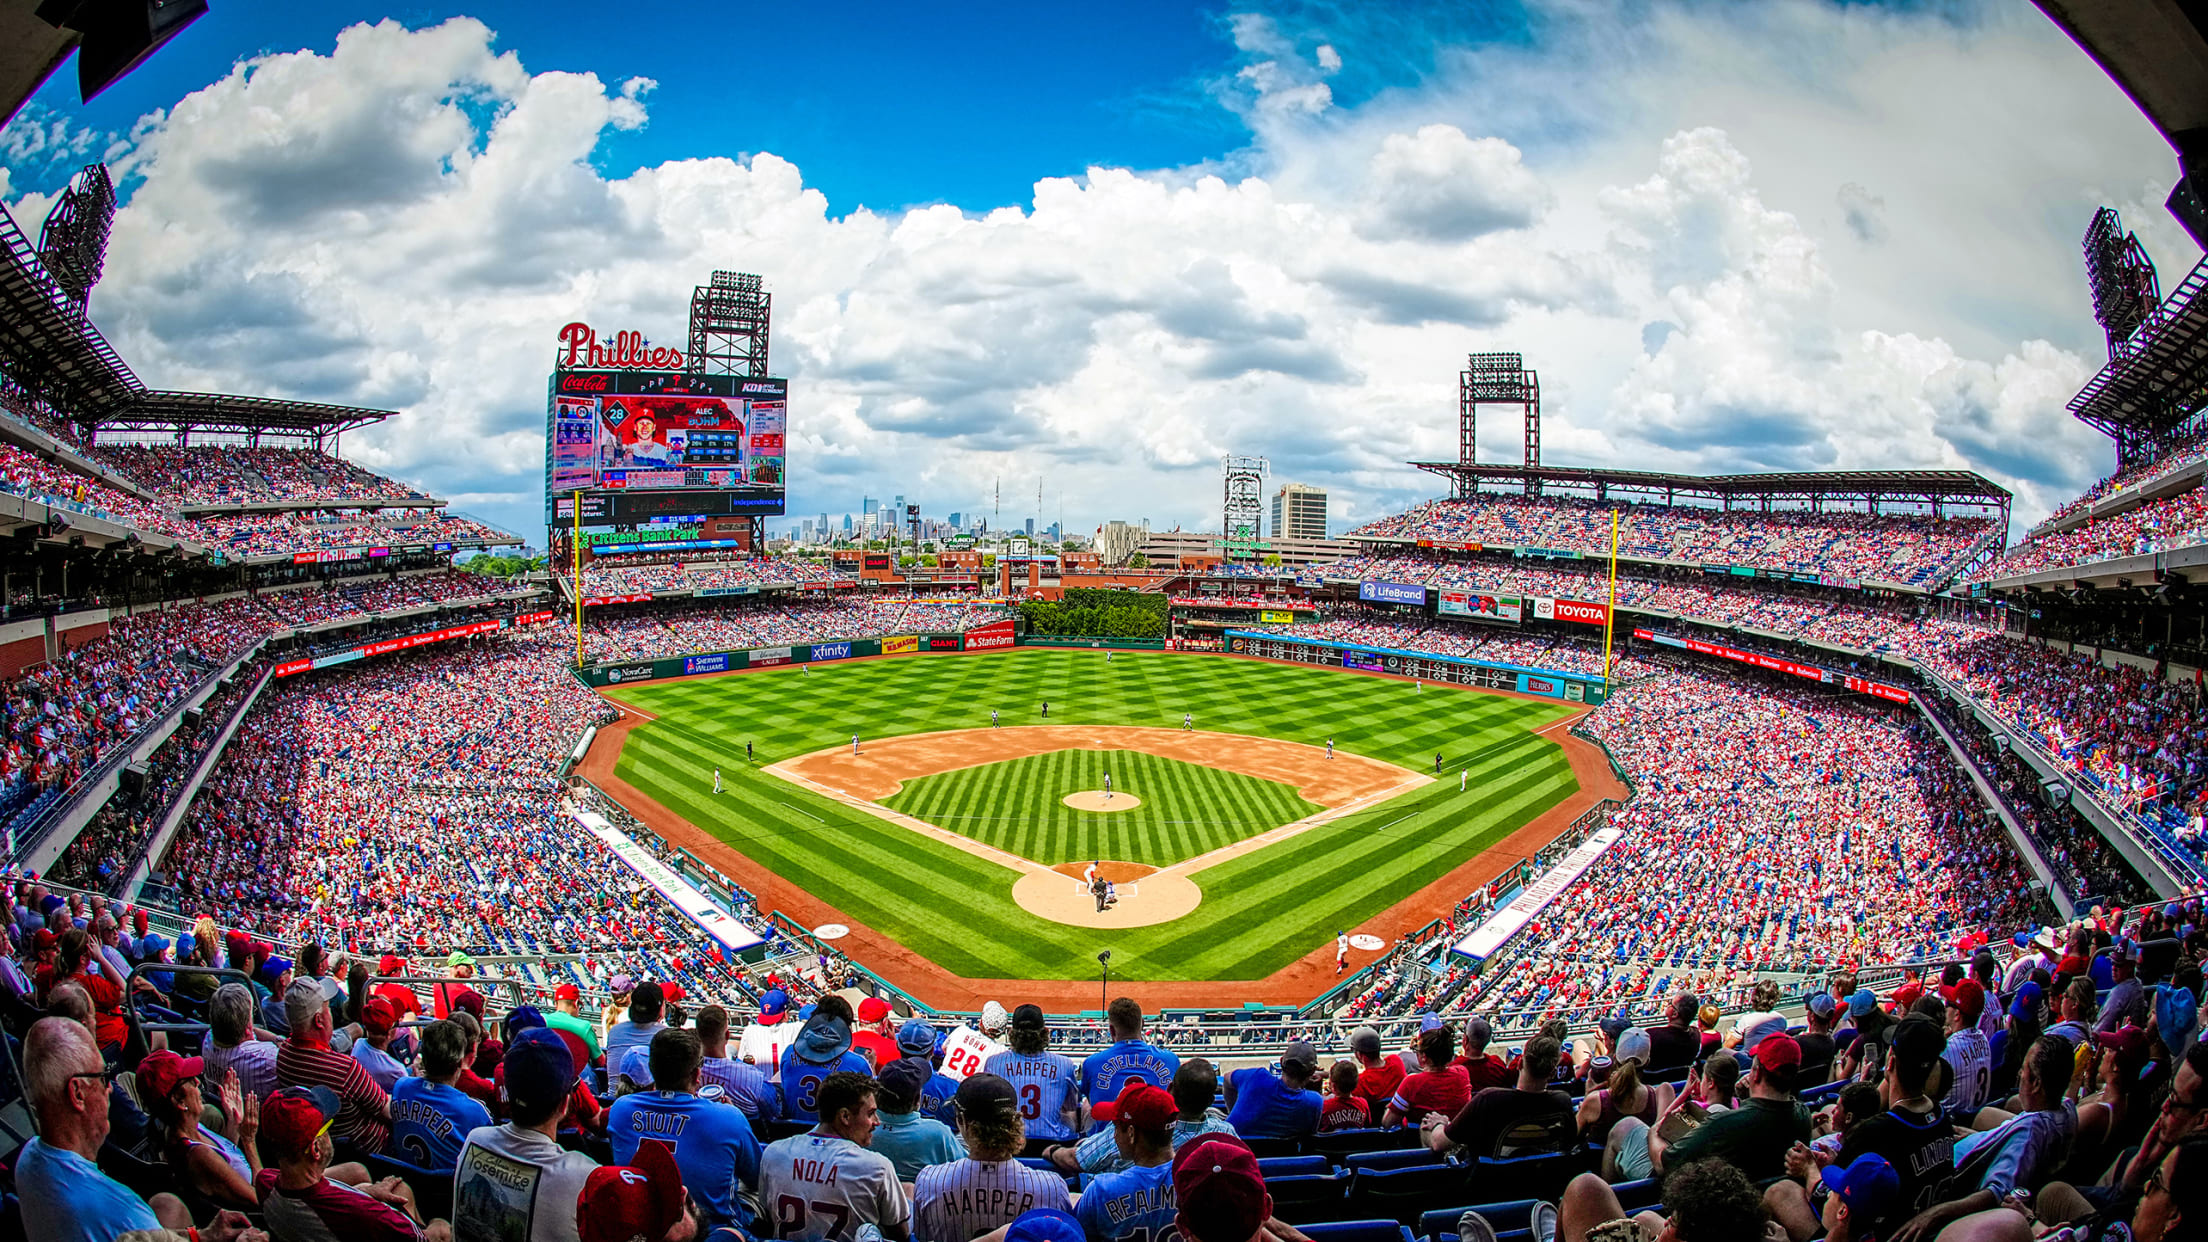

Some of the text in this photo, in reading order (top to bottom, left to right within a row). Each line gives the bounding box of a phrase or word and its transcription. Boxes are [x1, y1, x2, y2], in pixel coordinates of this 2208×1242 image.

[559, 322, 684, 369] Phillies
[610, 409, 624, 420] 28
[688, 416, 719, 426] BOHM
[591, 527, 699, 545] Citizens Bank Park
[1378, 586, 1422, 600] LifeBrand
[1557, 604, 1604, 620] TOYOTA
[930, 639, 958, 647] GIANT
[696, 655, 723, 665] SHERWIN
[814, 645, 849, 660] xfinity
[287, 662, 309, 672] Budweiser
[621, 667, 653, 676] NovaCare
[1797, 667, 1819, 678] Budweiser
[1530, 680, 1552, 691] HERR'S
[963, 1034, 987, 1053] BOHM
[948, 1047, 980, 1077] 28
[1006, 1062, 1057, 1079] HARPER
[1096, 1053, 1173, 1090] CASTELLANOS
[1021, 1084, 1041, 1120] 3
[391, 1099, 454, 1140] HARPER
[632, 1111, 690, 1136] STOTT
[1328, 1109, 1366, 1125] HOSKINS
[468, 1143, 530, 1188] Yosemite
[1910, 1137, 1955, 1176] LINDO
[793, 1158, 838, 1188] NOLA
[943, 1188, 1034, 1218] HARPER
[1105, 1184, 1178, 1224] REALM
[778, 1193, 849, 1242] 27
